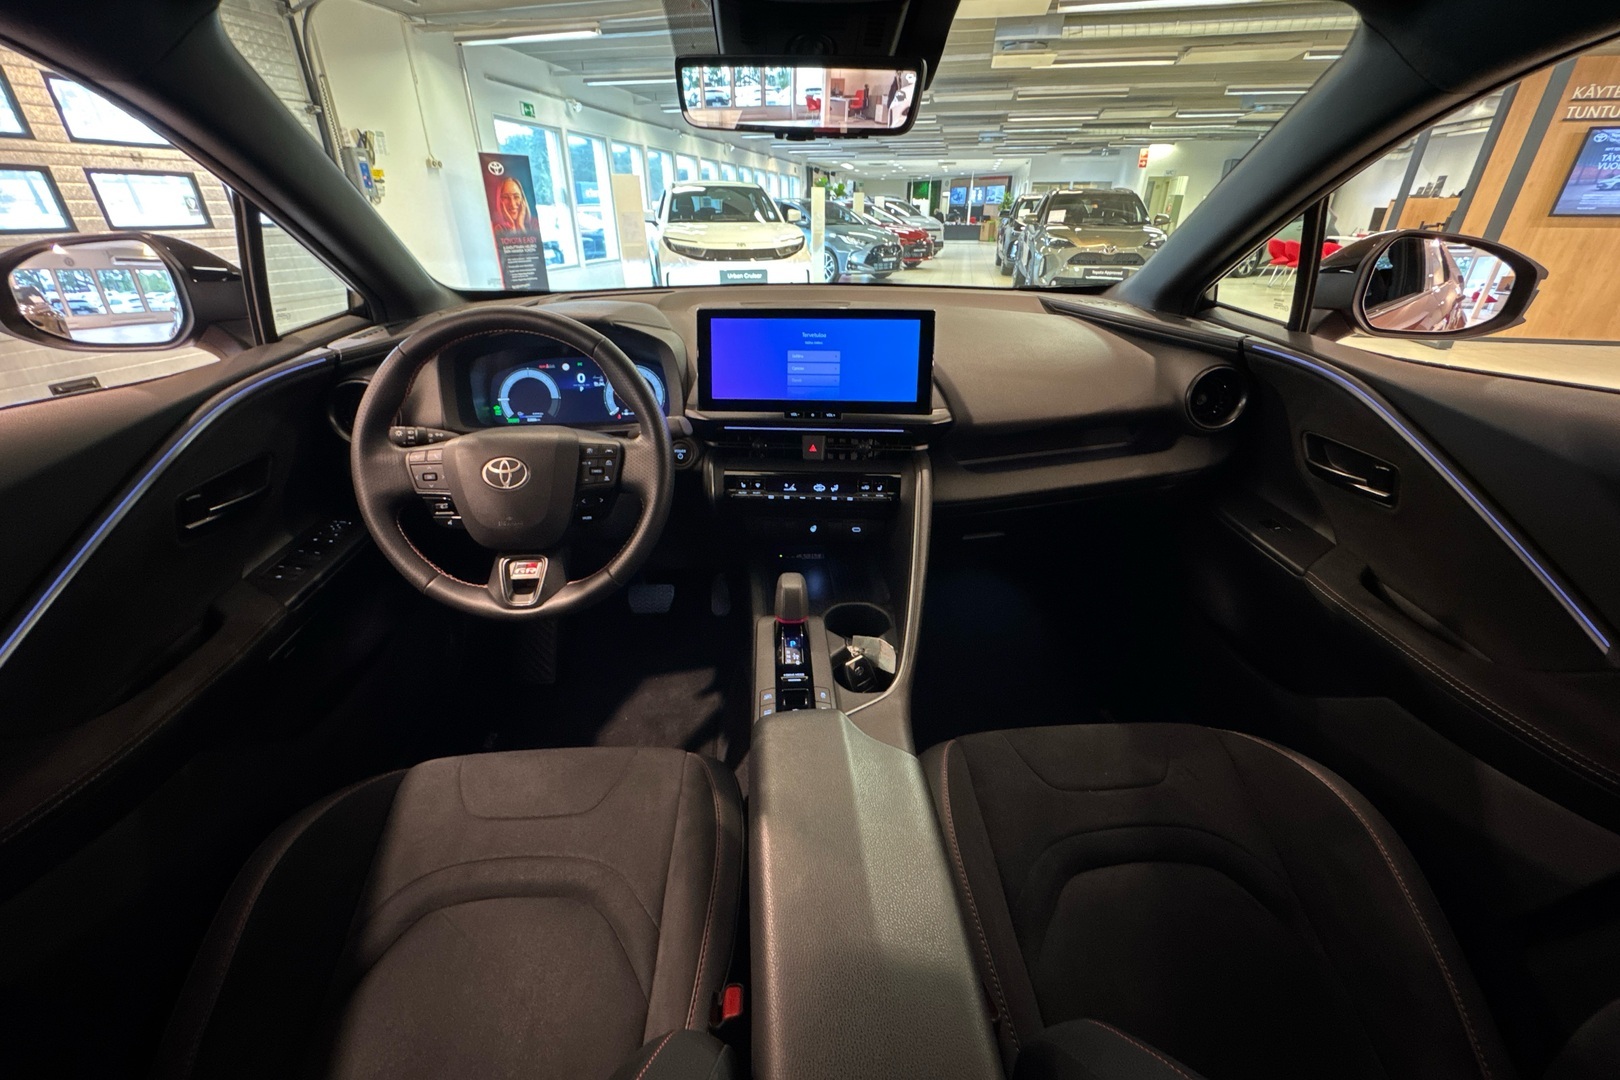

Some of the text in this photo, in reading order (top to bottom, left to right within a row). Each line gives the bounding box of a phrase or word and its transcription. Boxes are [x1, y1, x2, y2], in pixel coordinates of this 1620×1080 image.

[1566, 105, 1620, 119] TUNTU
[501, 237, 522, 245] TOYOTA
[577, 373, 586, 384] 0
